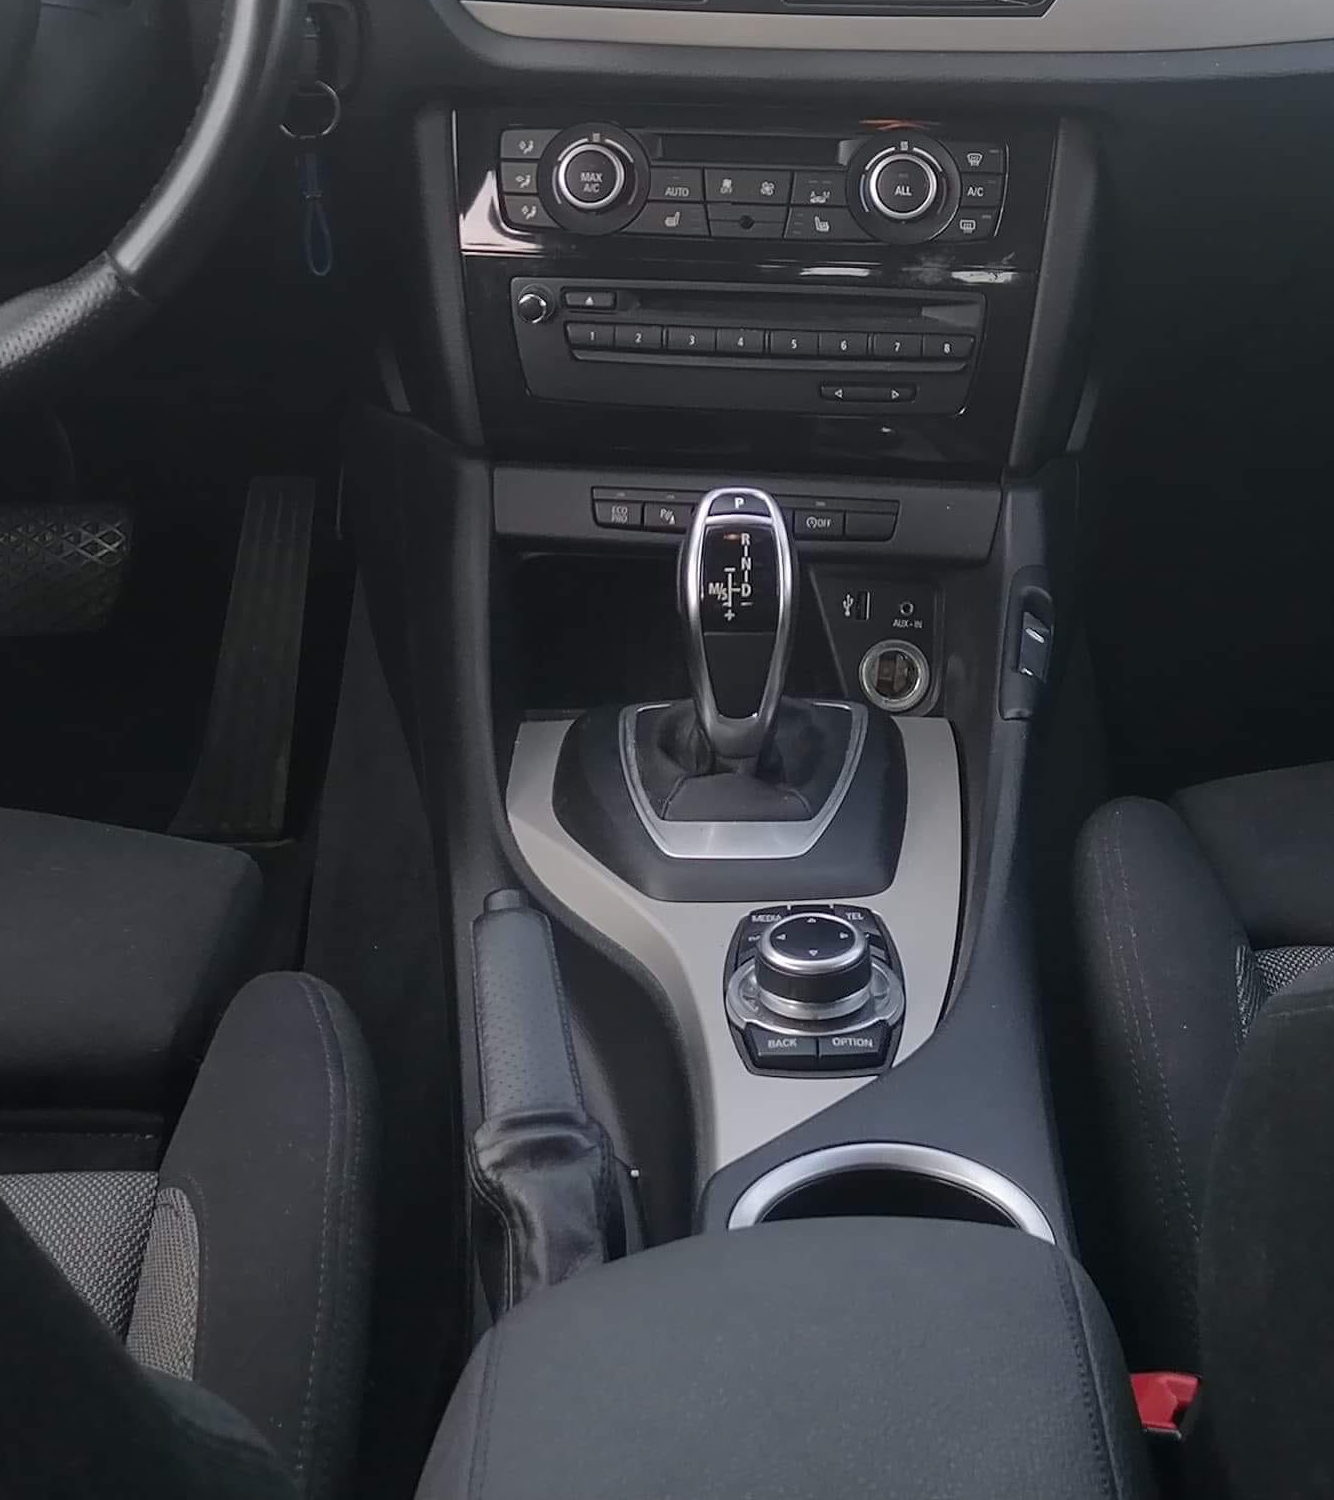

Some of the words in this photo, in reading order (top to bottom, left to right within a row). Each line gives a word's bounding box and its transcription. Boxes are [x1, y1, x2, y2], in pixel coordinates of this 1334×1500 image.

[580, 171, 603, 183] MAX
[583, 182, 601, 193] A/C
[664, 186, 690, 198] AUTO
[894, 185, 912, 196] ALL
[967, 186, 984, 197] A/C
[589, 331, 595, 342] 1
[634, 332, 643, 343] 2
[687, 334, 695, 346] 3
[737, 336, 744, 347] 4
[790, 337, 798, 349] 5
[840, 339, 848, 351] 6
[893, 341, 901, 353] 7
[943, 342, 951, 354] 8
[734, 497, 745, 509] P
[611, 506, 628, 516] ECO
[817, 518, 832, 529] OFF
[741, 533, 751, 546] R
[741, 557, 751, 570] N
[708, 582, 728, 601] M/S
[741, 584, 751, 597] D
[751, 913, 782, 923] MEDIA
[846, 911, 864, 921] TEL
[767, 1038, 797, 1049] BACK
[831, 1037, 873, 1049] OPTION
